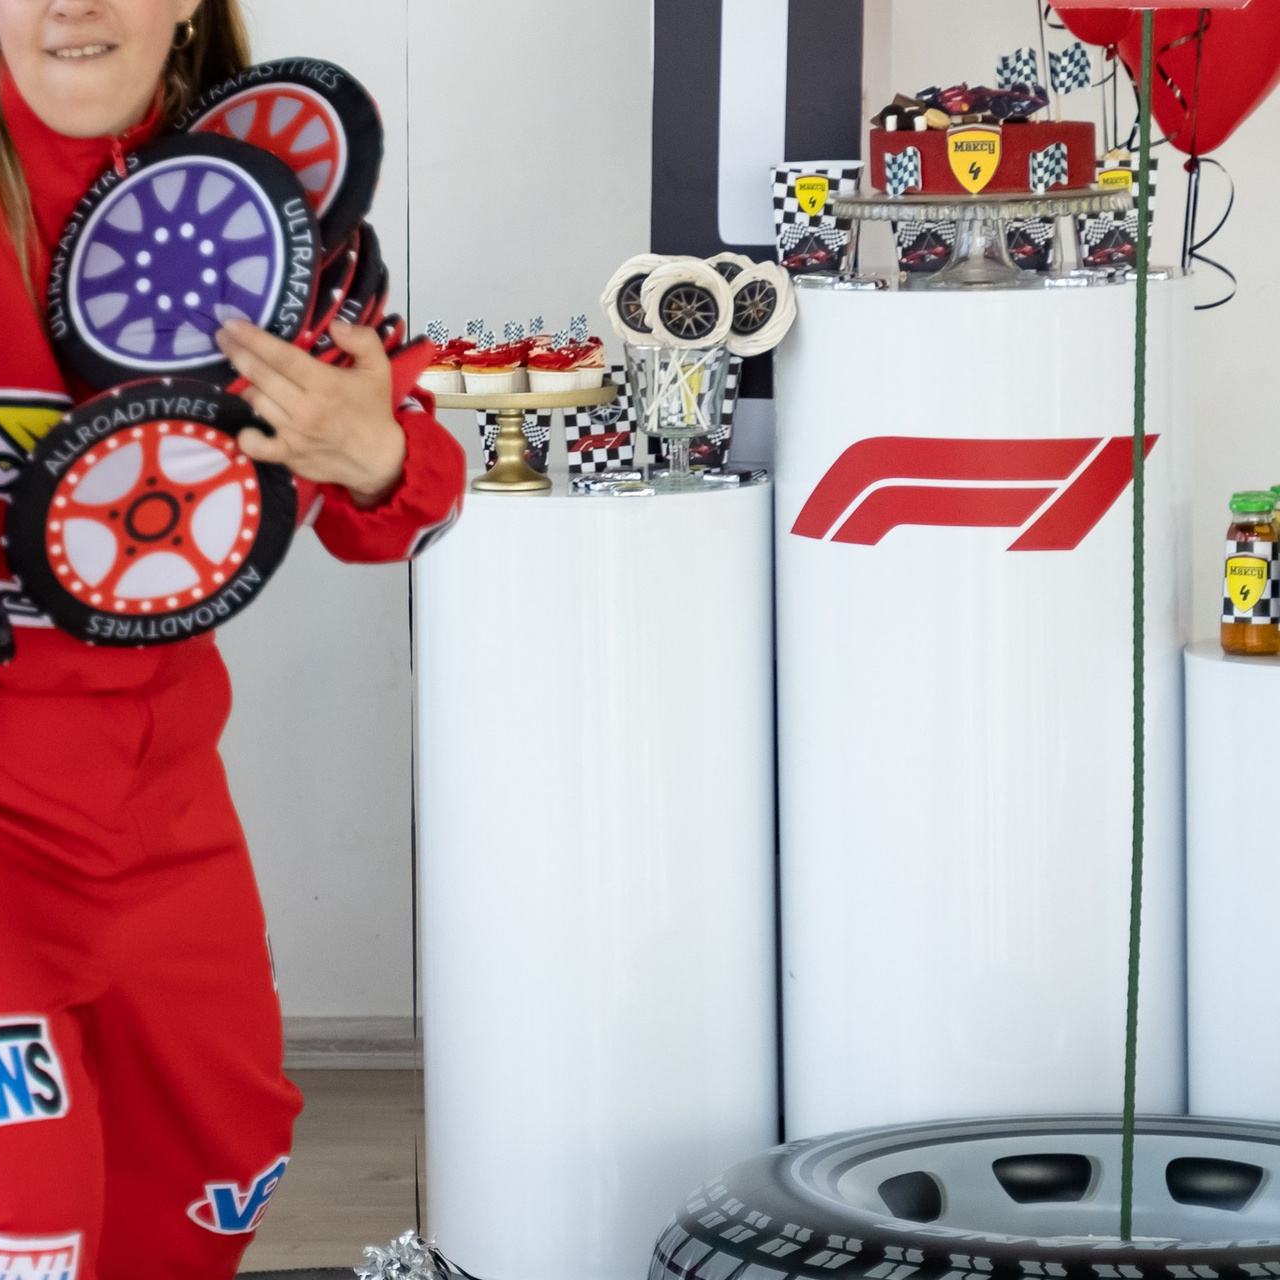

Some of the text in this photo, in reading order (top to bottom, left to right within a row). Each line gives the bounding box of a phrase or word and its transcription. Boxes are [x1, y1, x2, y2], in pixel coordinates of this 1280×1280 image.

[968, 161, 982, 181] 4
[809, 196, 817, 208] 4
[48, 152, 139, 338] ULTRAFASTTYRS
[44, 396, 219, 477] ALLROADTYRES
[86, 565, 263, 640] ALLROADTYRES
[1239, 584, 1251, 601] 4
